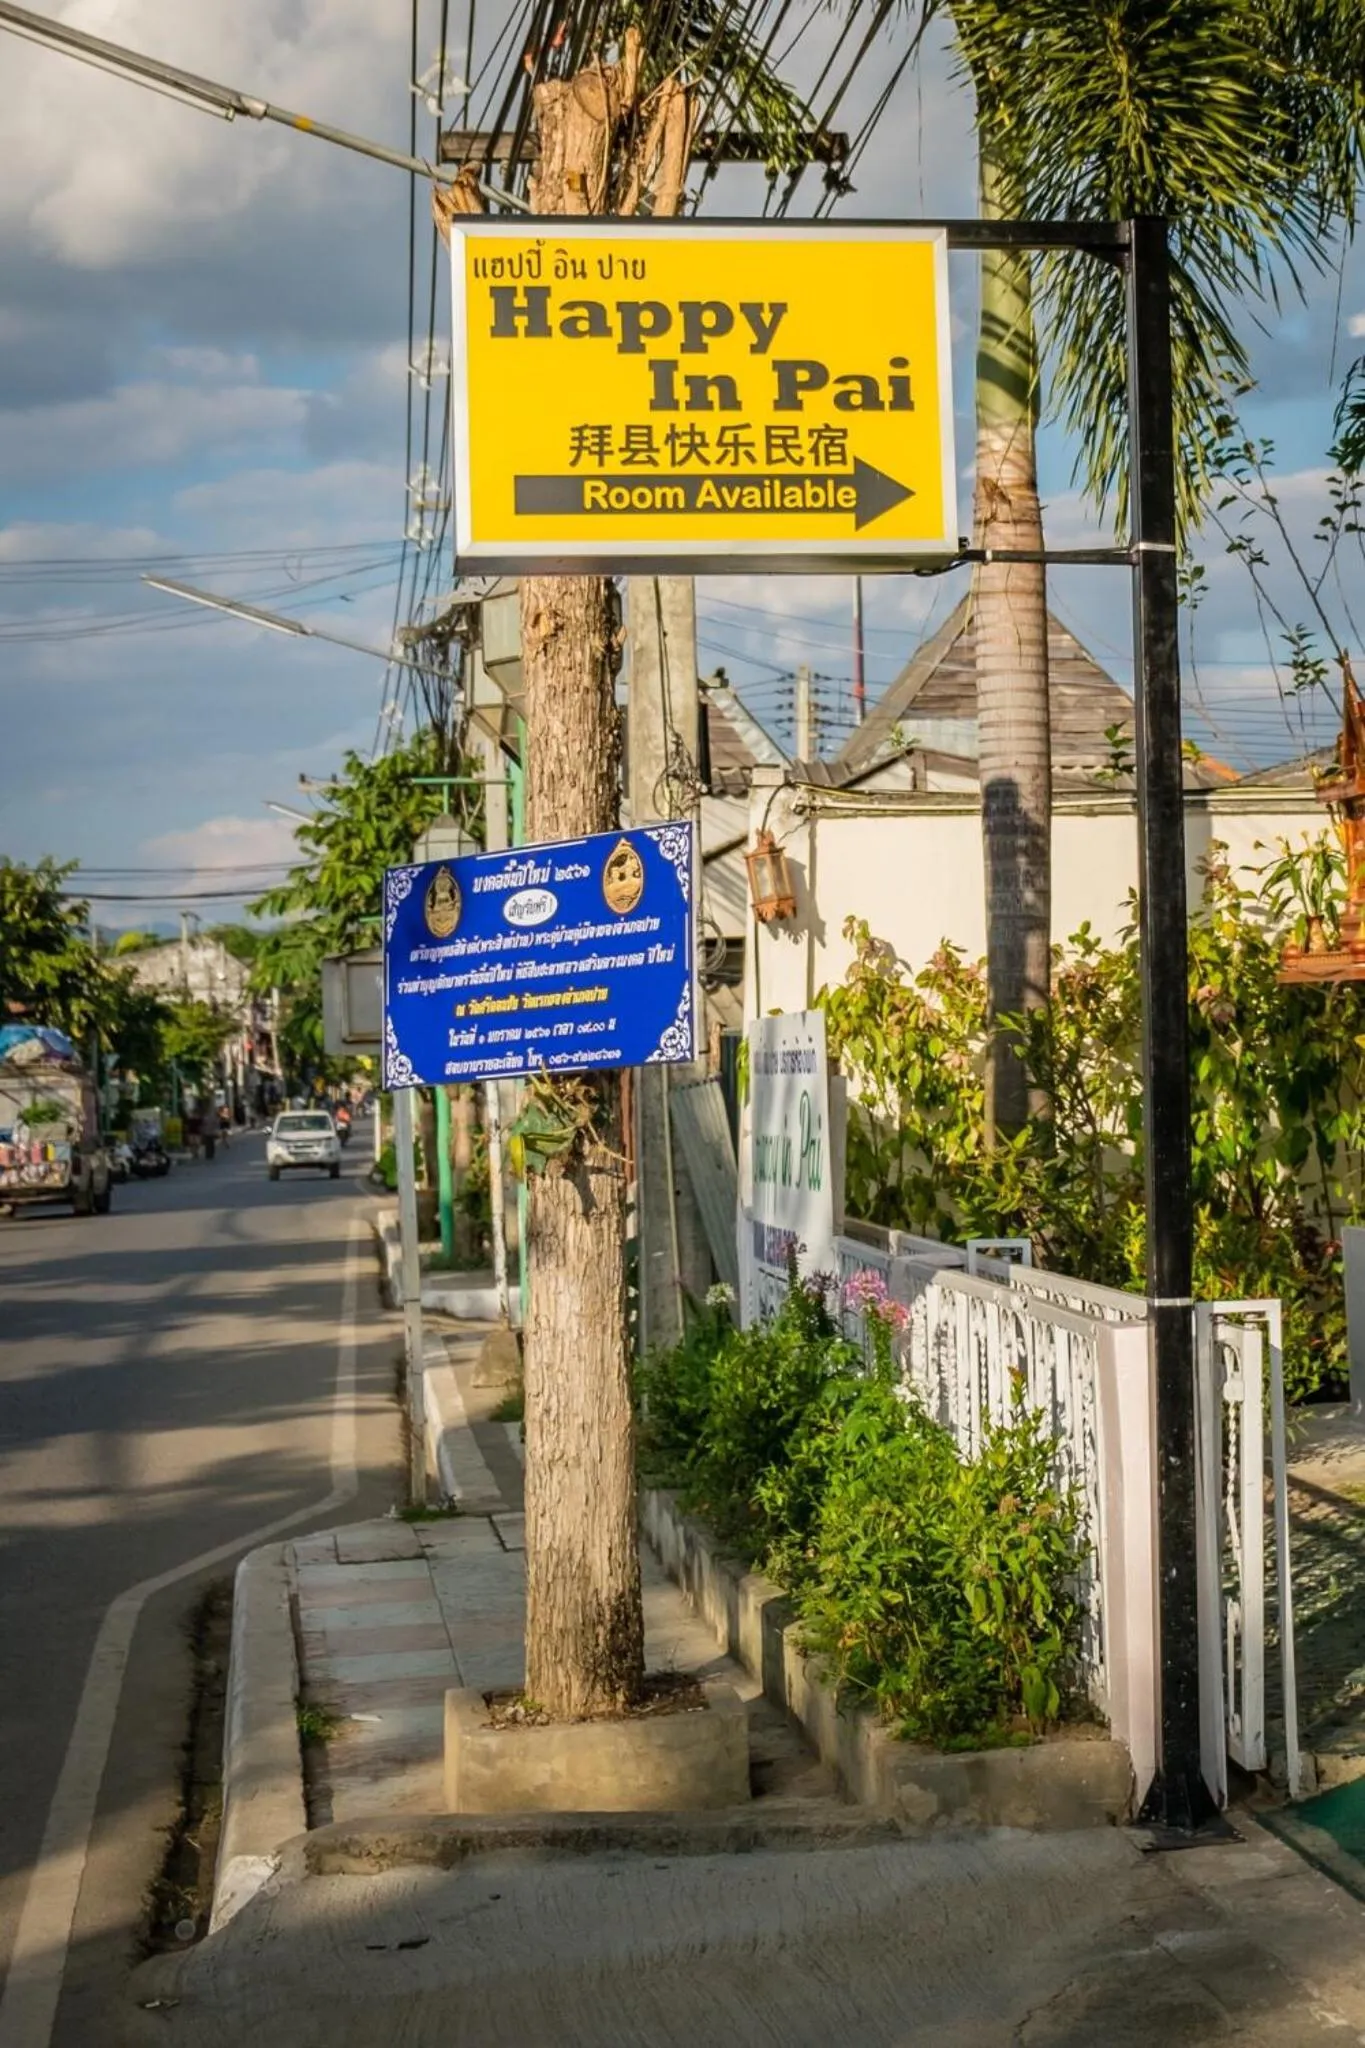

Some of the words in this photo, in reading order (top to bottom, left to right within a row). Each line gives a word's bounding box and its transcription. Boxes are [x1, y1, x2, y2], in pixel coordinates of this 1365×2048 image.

[473, 239, 545, 280] แฮปปี้
[553, 248, 588, 280] อิน
[597, 257, 646, 280] ปาย
[488, 285, 788, 355] Happy
[648, 359, 742, 412] In
[771, 356, 915, 412] Pai
[569, 423, 850, 468] 拜县快乐民宿
[582, 480, 686, 510] Room
[694, 478, 857, 510] Available
[796, 1090, 823, 1192] Pai
